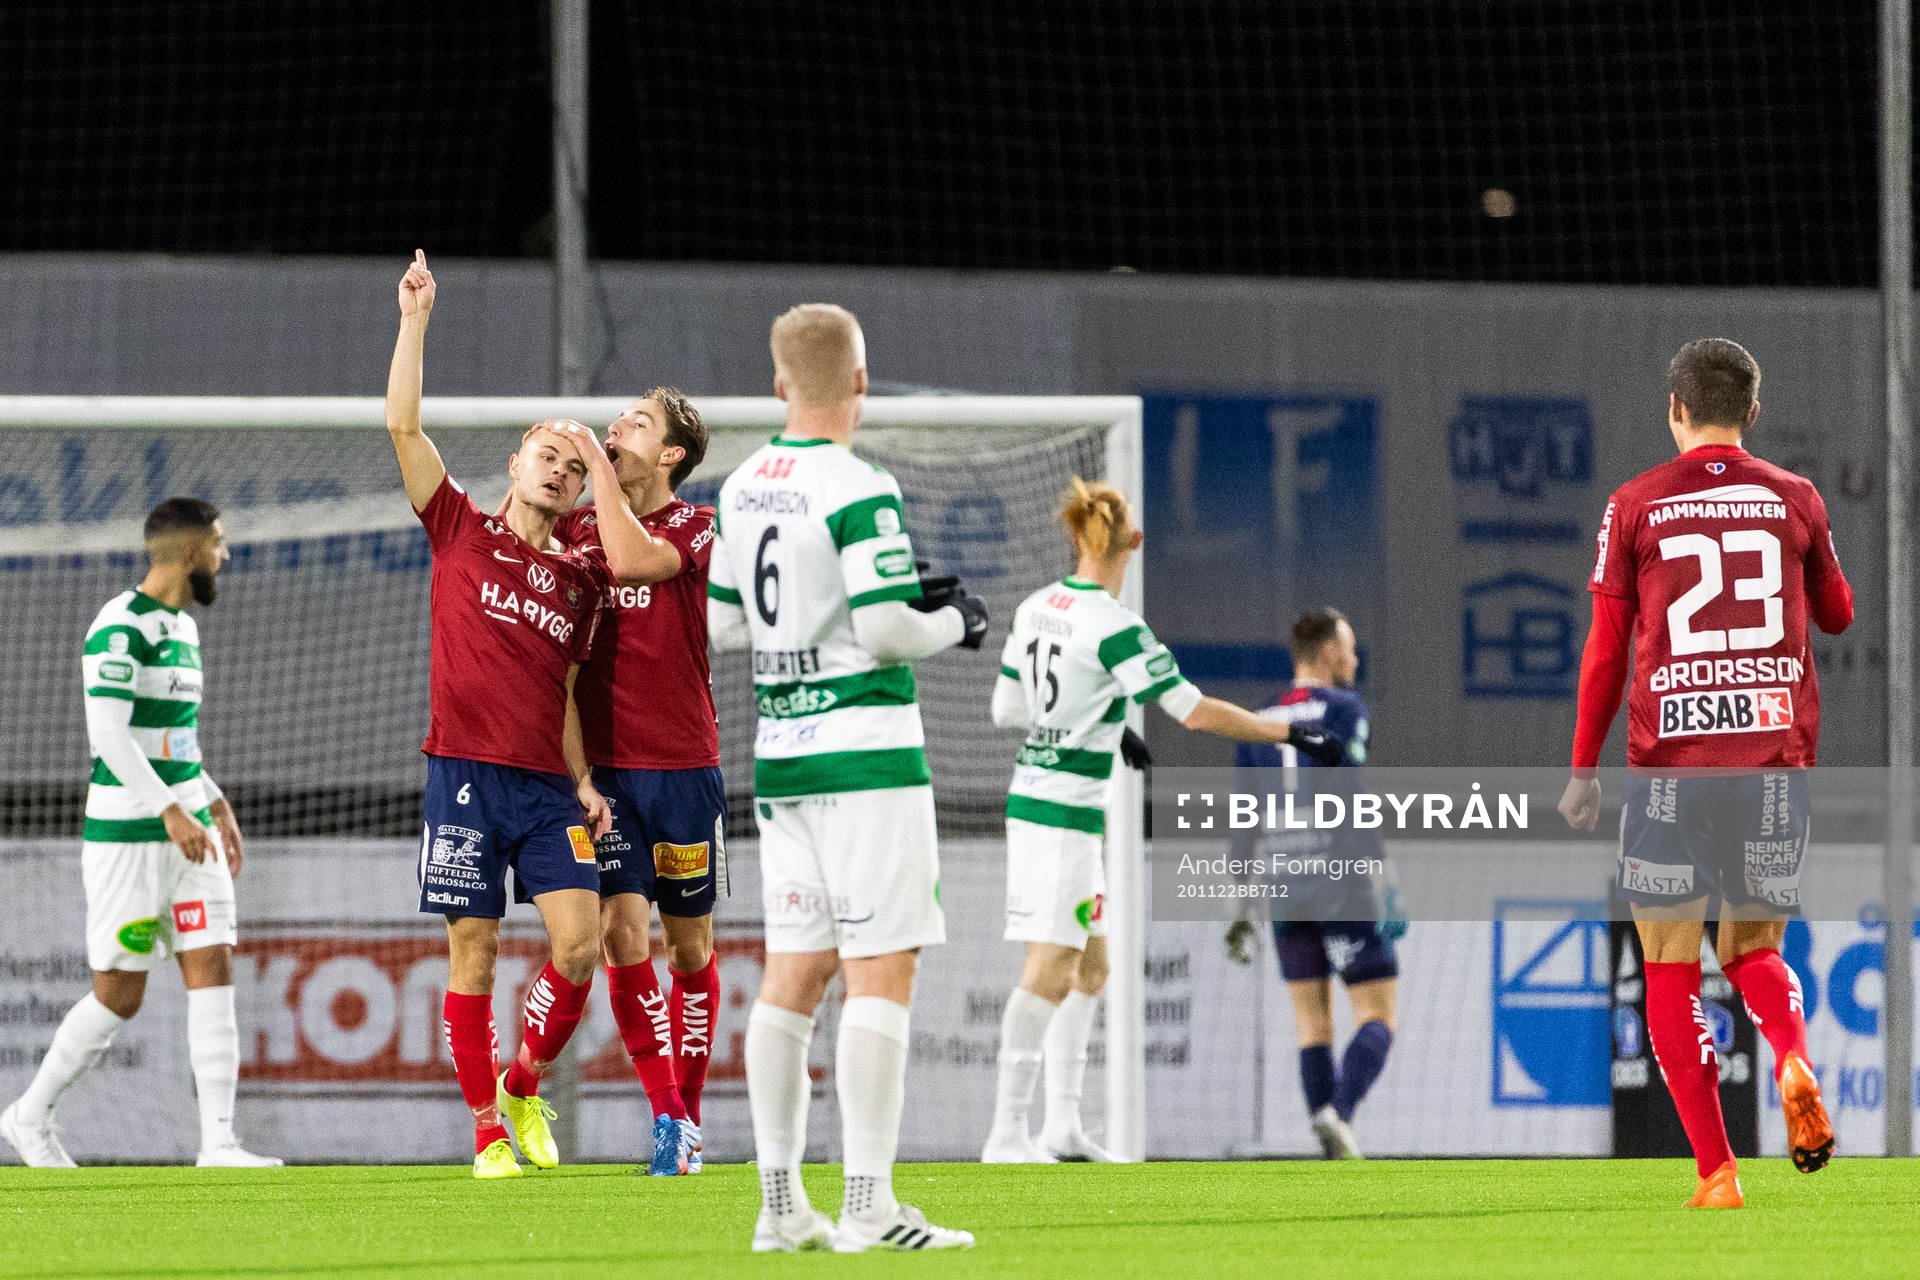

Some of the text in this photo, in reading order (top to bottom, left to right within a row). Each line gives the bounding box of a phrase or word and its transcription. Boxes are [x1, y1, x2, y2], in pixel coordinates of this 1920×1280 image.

[1649, 503, 1787, 527] HAMMARVIKEN
[755, 525, 780, 628] 6
[1658, 529, 1785, 657] 23
[1027, 637, 1062, 714] 15
[1650, 656, 1804, 692] BRORSSON
[1662, 693, 1755, 734] BESAB
[456, 782, 471, 805] 6
[658, 847, 705, 861] TRIUMF
[1744, 840, 1793, 854] REINE
[1628, 870, 1692, 894] RASTA
[1744, 864, 1797, 878] INVEST
[1752, 884, 1800, 906] RAST
[636, 985, 672, 1057] MIKE
[680, 991, 708, 1057] MIKE
